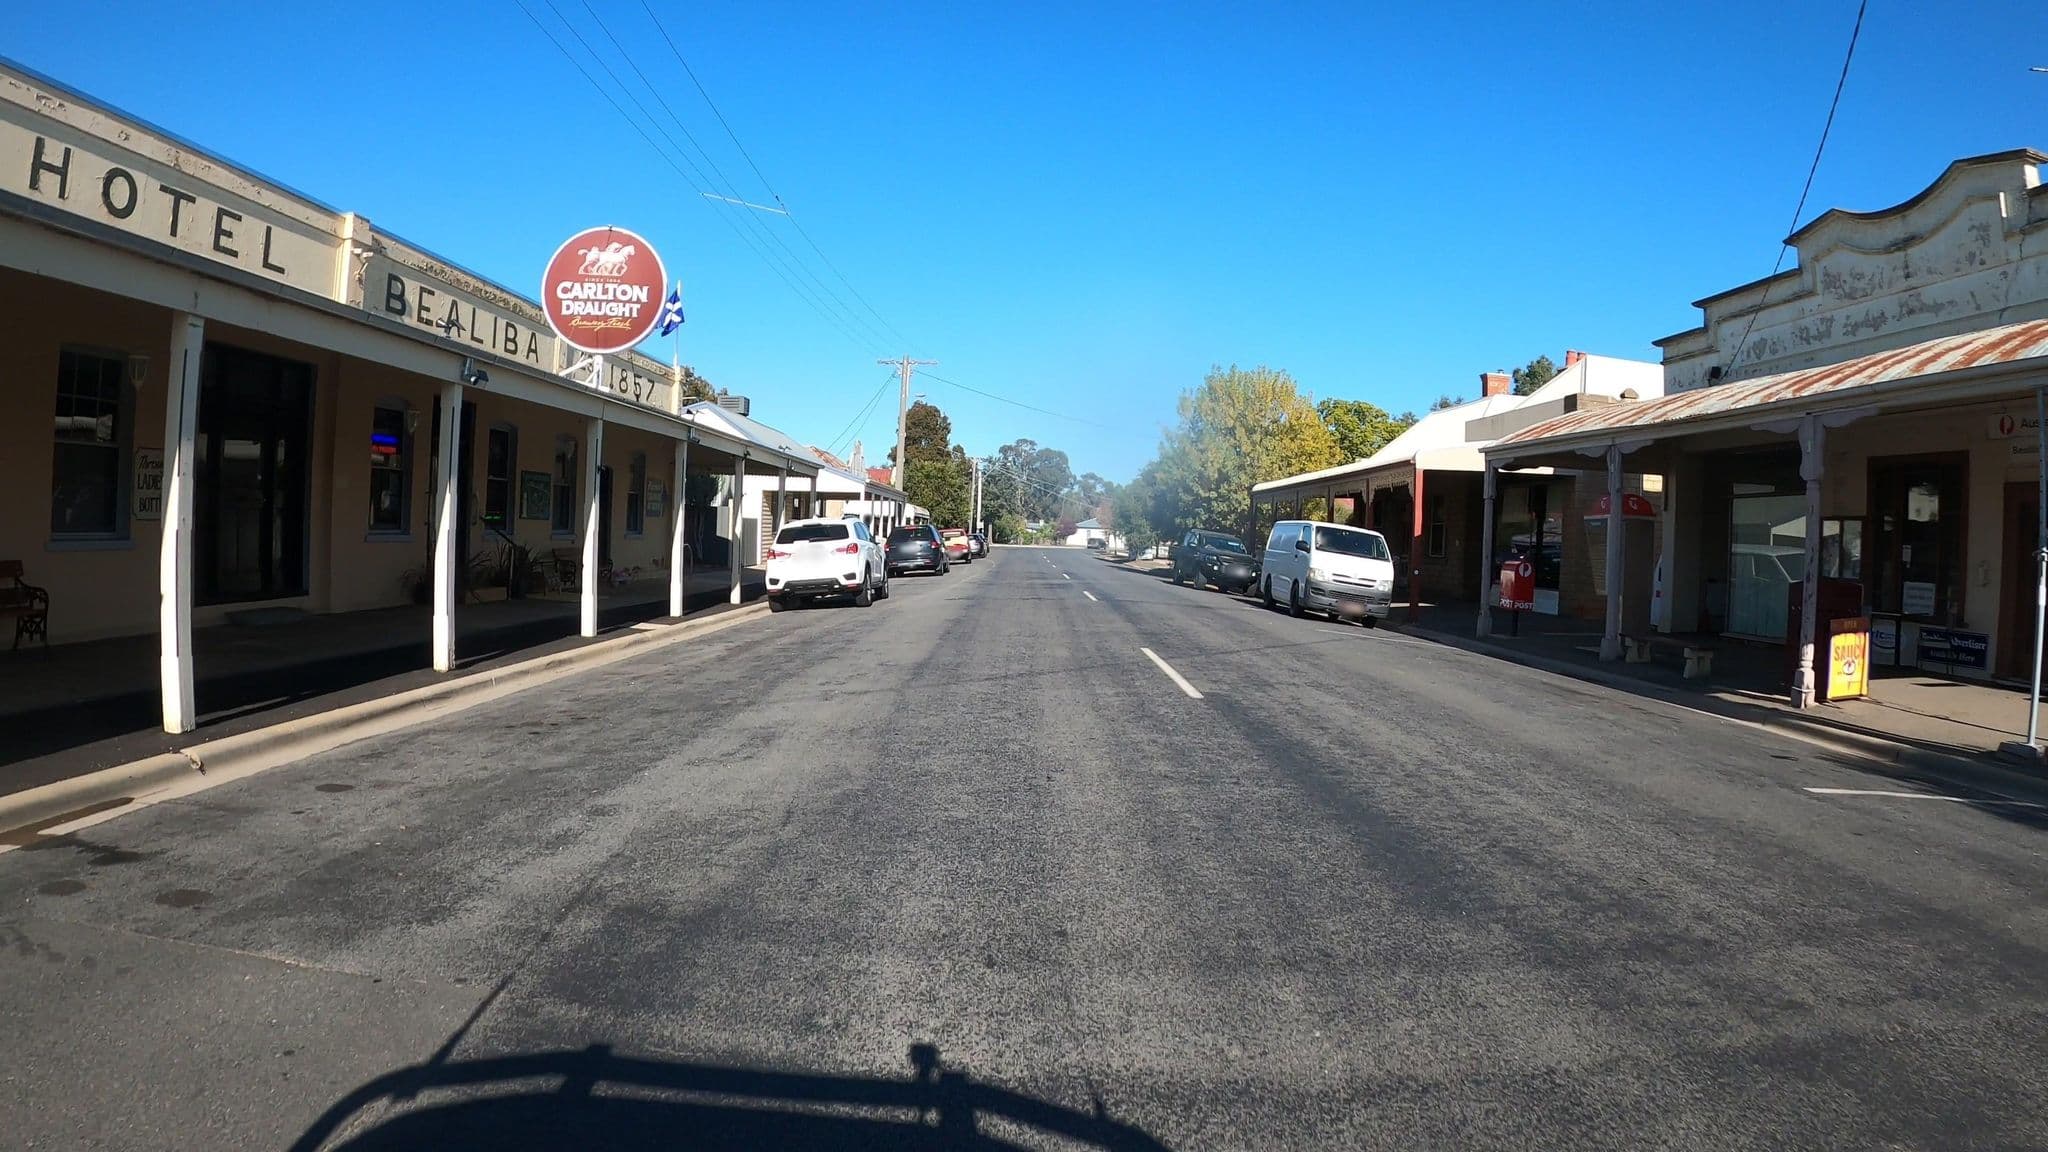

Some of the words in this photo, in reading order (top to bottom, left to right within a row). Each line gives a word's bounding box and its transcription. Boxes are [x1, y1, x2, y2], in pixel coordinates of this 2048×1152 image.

[29, 136, 286, 275] HOTEL
[556, 281, 650, 303] CARLTON
[561, 300, 641, 318] DRAUGHT
[384, 272, 539, 364] BEALIBA
[609, 364, 656, 401] 1857
